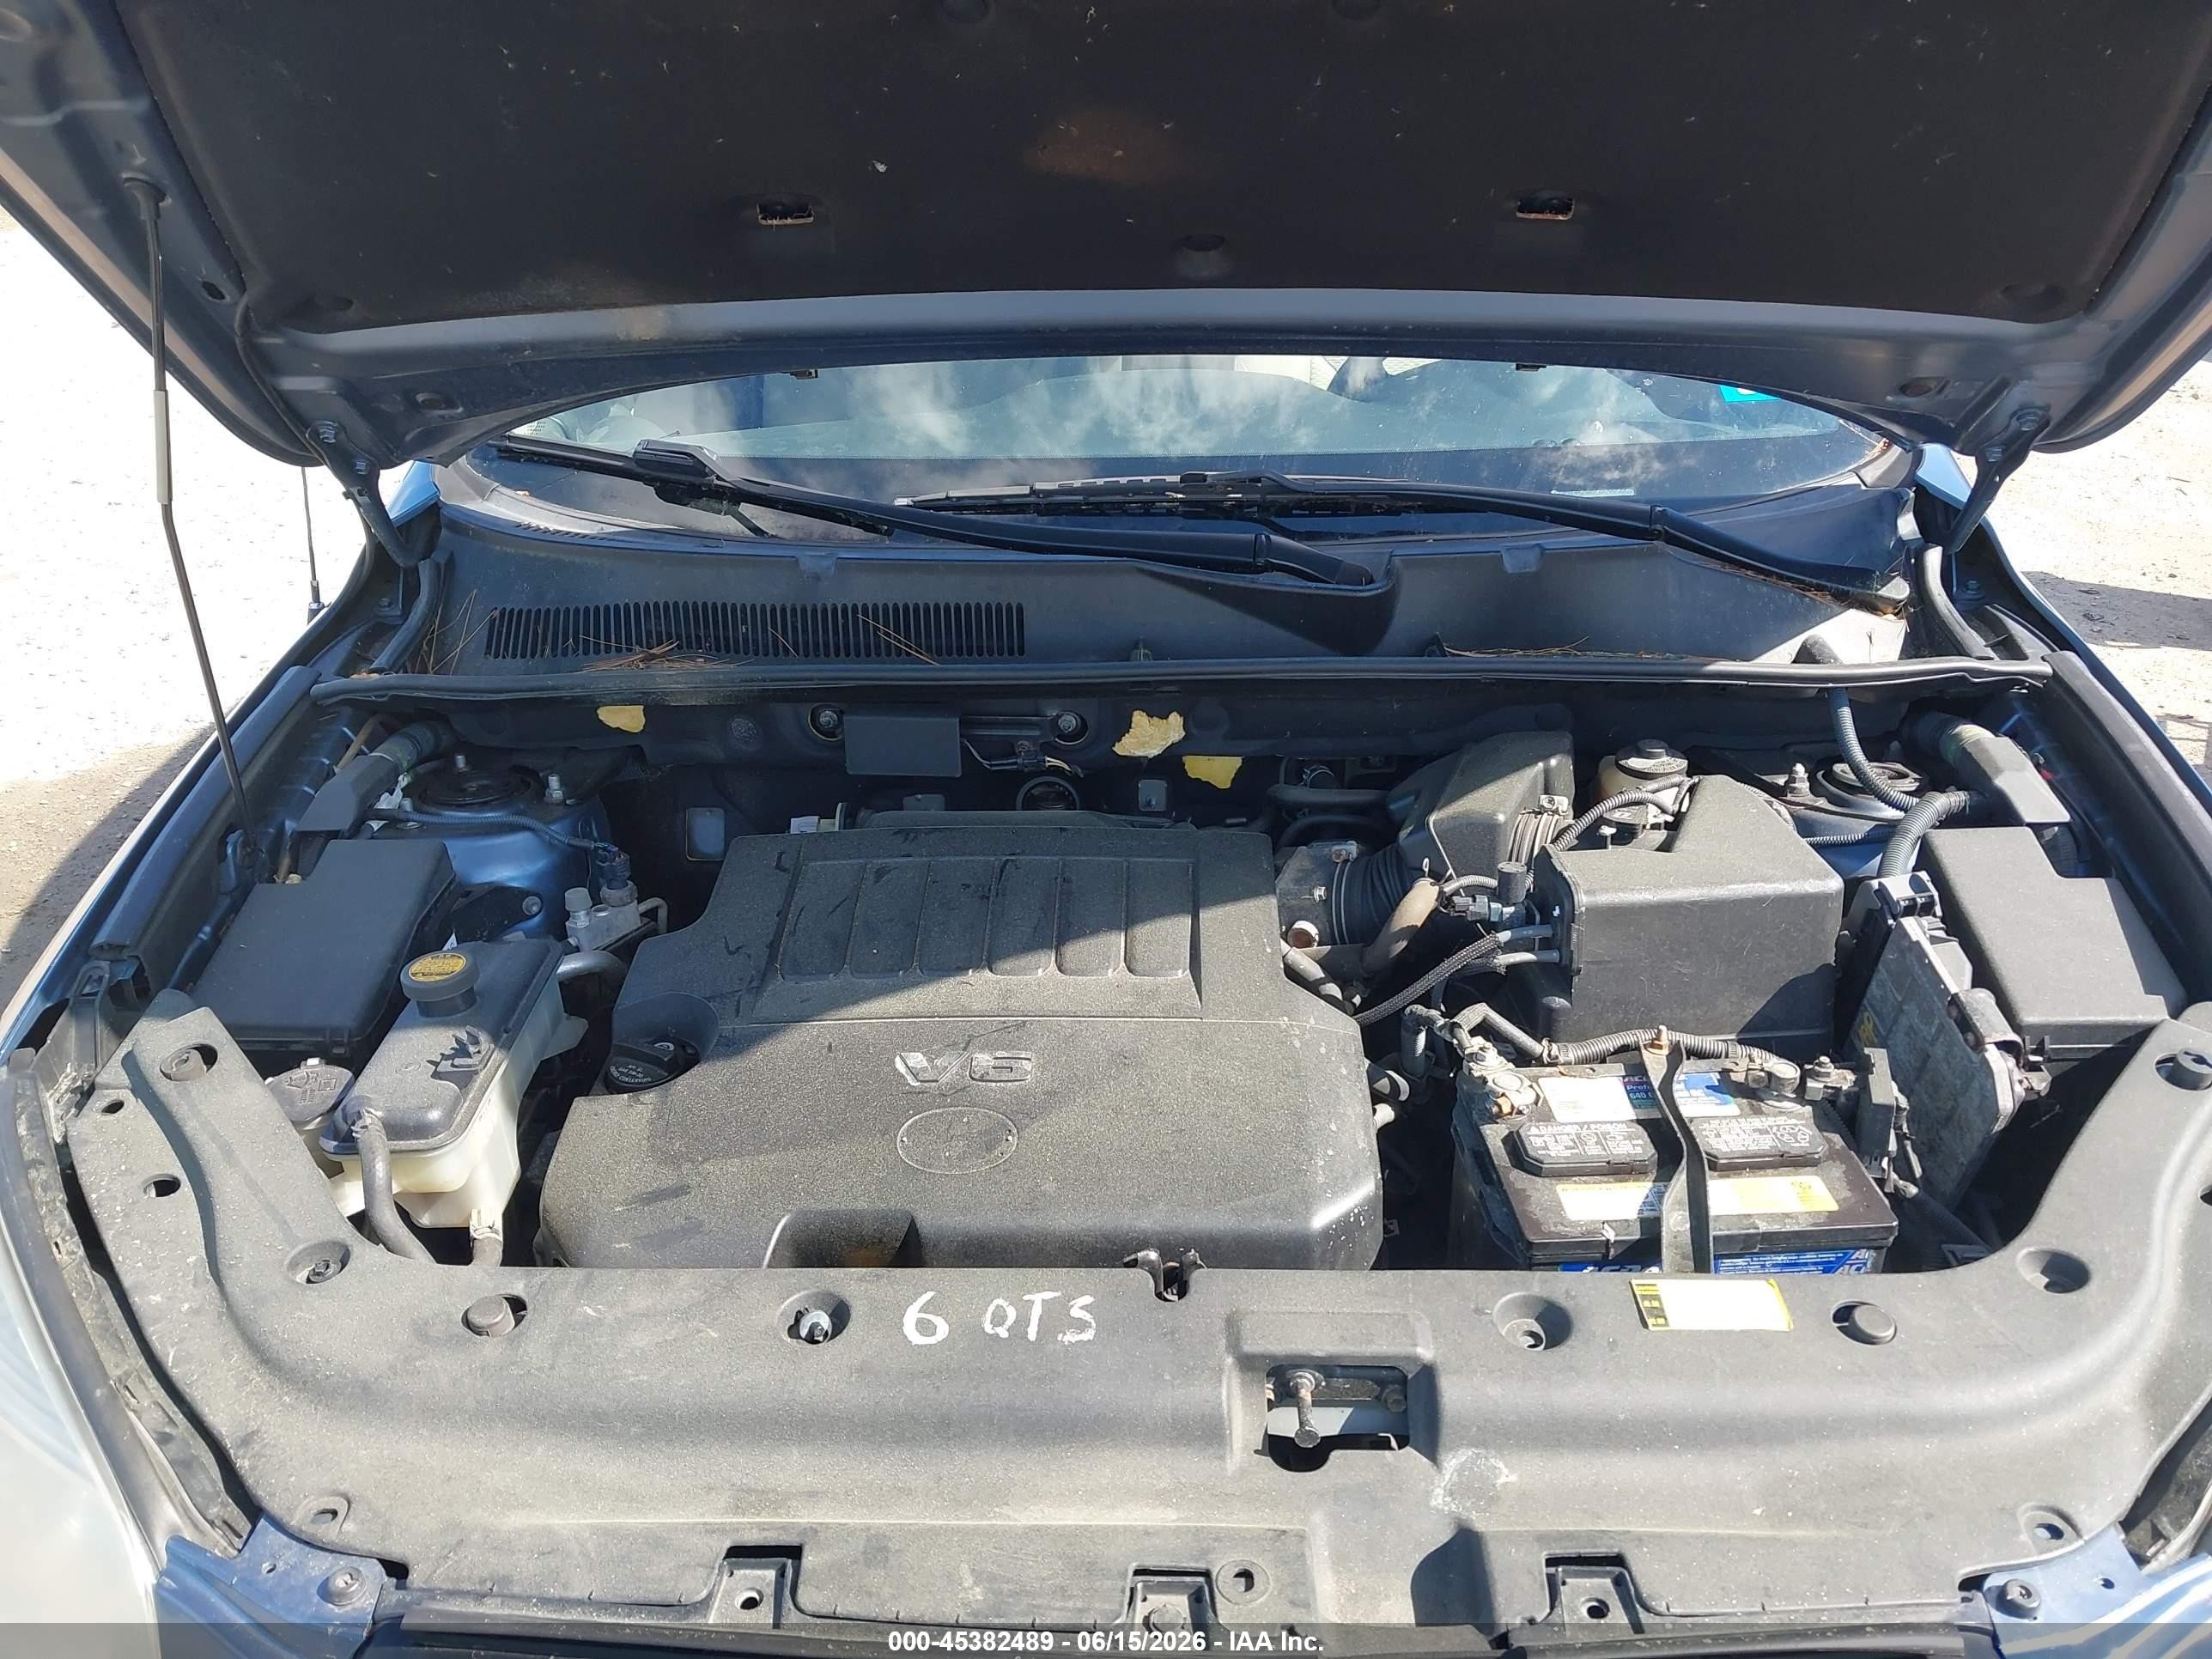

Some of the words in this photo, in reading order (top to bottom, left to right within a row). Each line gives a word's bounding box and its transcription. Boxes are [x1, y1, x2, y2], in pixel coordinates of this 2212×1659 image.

[895, 1051, 1032, 1085] V6
[902, 1291, 950, 1346] 6
[982, 1291, 1097, 1345] QTS
